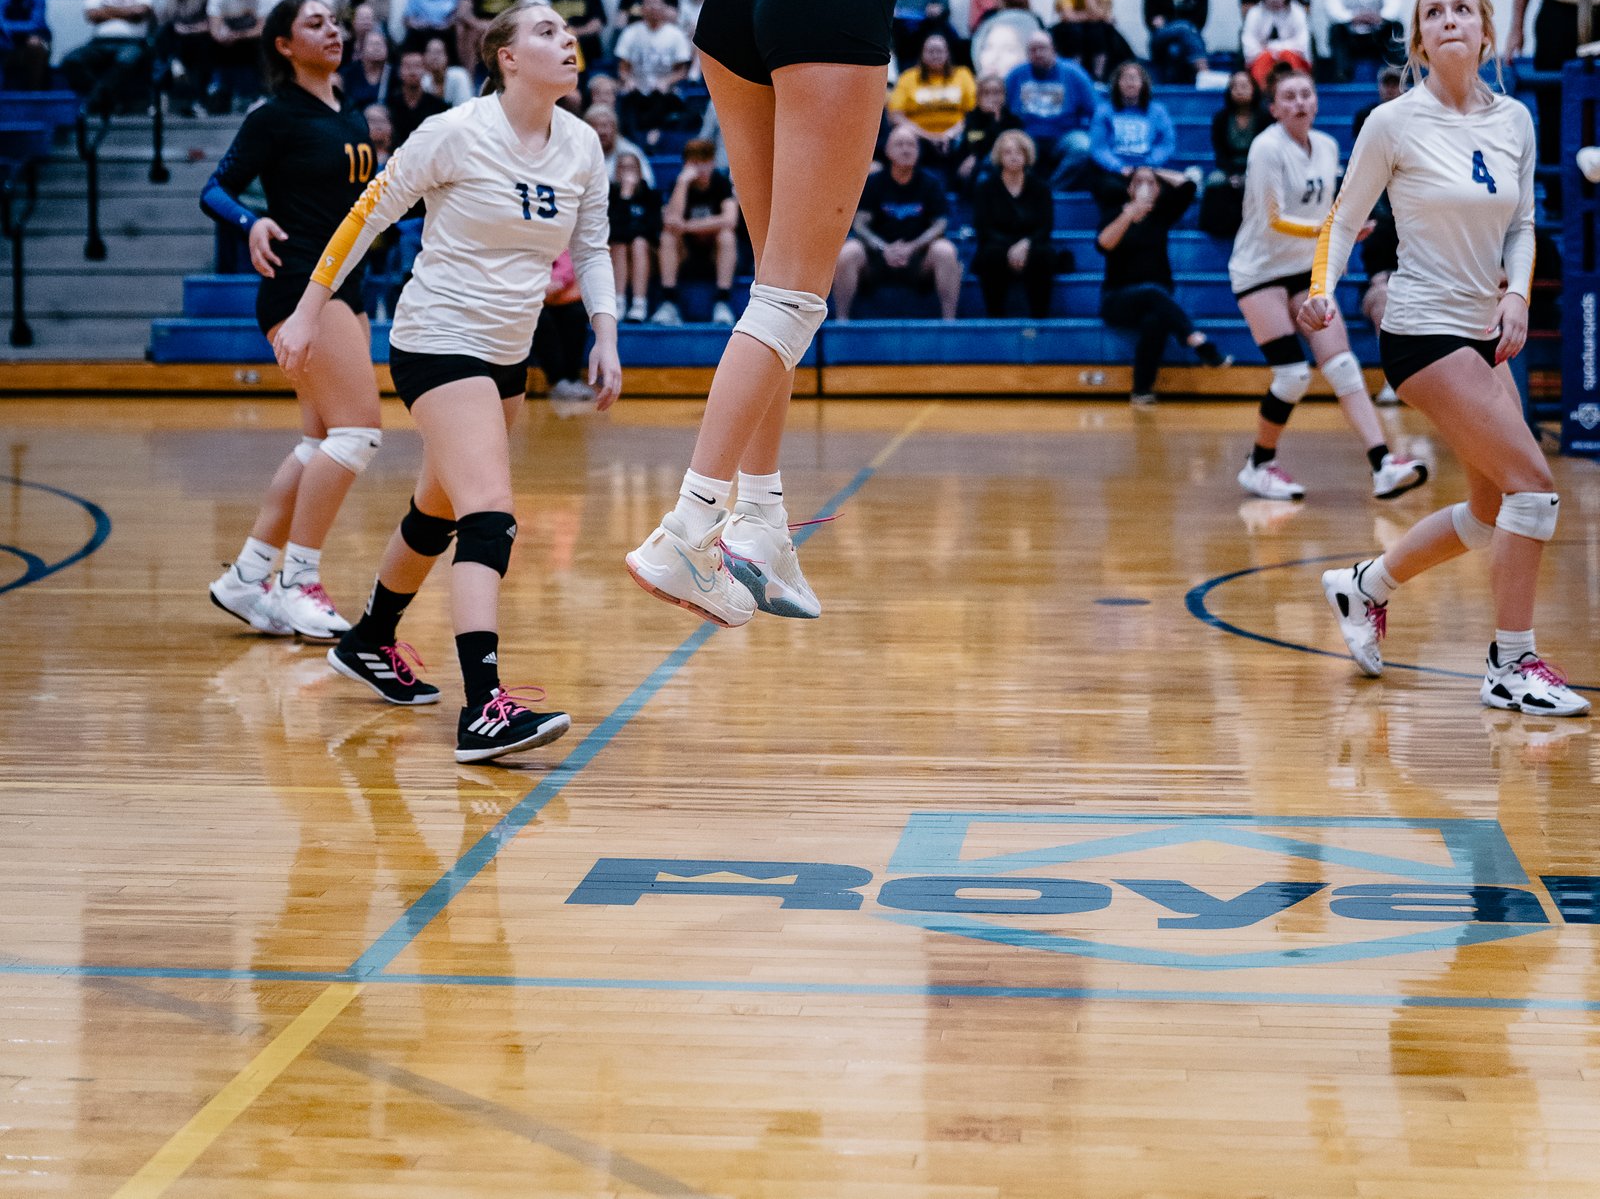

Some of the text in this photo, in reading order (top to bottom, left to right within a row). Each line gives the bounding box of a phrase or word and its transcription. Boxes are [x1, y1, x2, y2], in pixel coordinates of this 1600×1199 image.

[344, 142, 373, 184] 10
[1472, 149, 1497, 194] 4
[515, 182, 559, 221] 13
